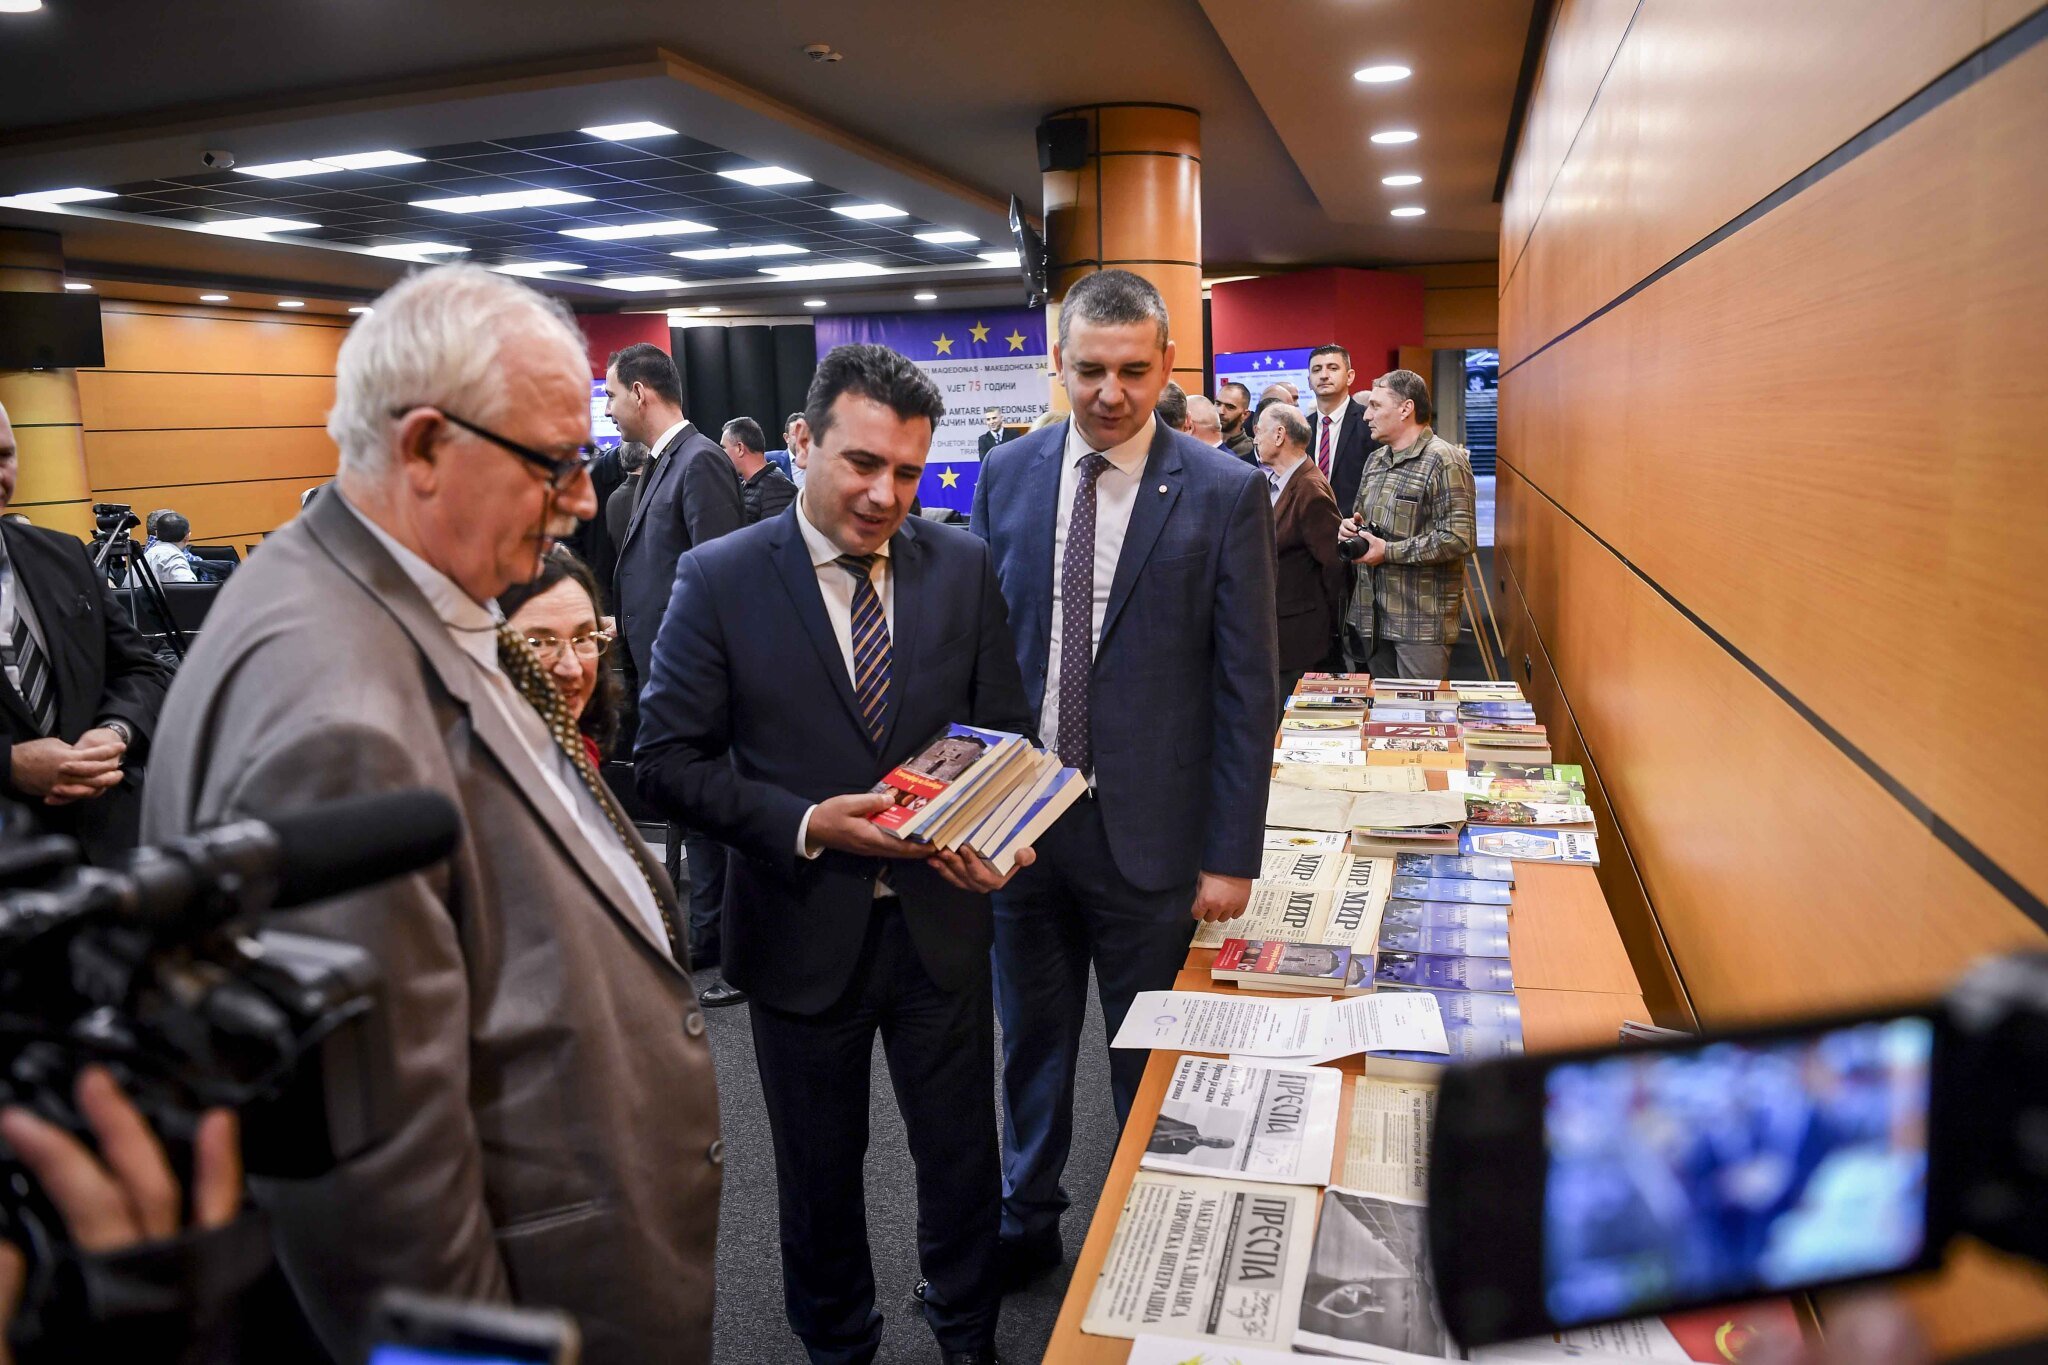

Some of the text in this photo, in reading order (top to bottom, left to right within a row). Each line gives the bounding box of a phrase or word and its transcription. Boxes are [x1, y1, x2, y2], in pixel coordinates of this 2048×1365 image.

[931, 366, 979, 374] MAQEDONAS
[984, 364, 1033, 372] МАКЕДОНСКА
[946, 380, 1016, 392] VJET 75 ГОДИНИ
[949, 407, 981, 415] AMTARE
[1291, 854, 1322, 880] МИР
[1348, 860, 1372, 886] МИР
[1282, 891, 1314, 928] МИР
[1335, 891, 1369, 930] МИР
[1186, 1200, 1216, 1261] МАКЕДОНСКА
[1142, 1190, 1196, 1323] ЗА ЕВРОПСКА ИНТЕГРАЦИЈА
[1170, 1263, 1200, 1317] АЛИЈАНСА
